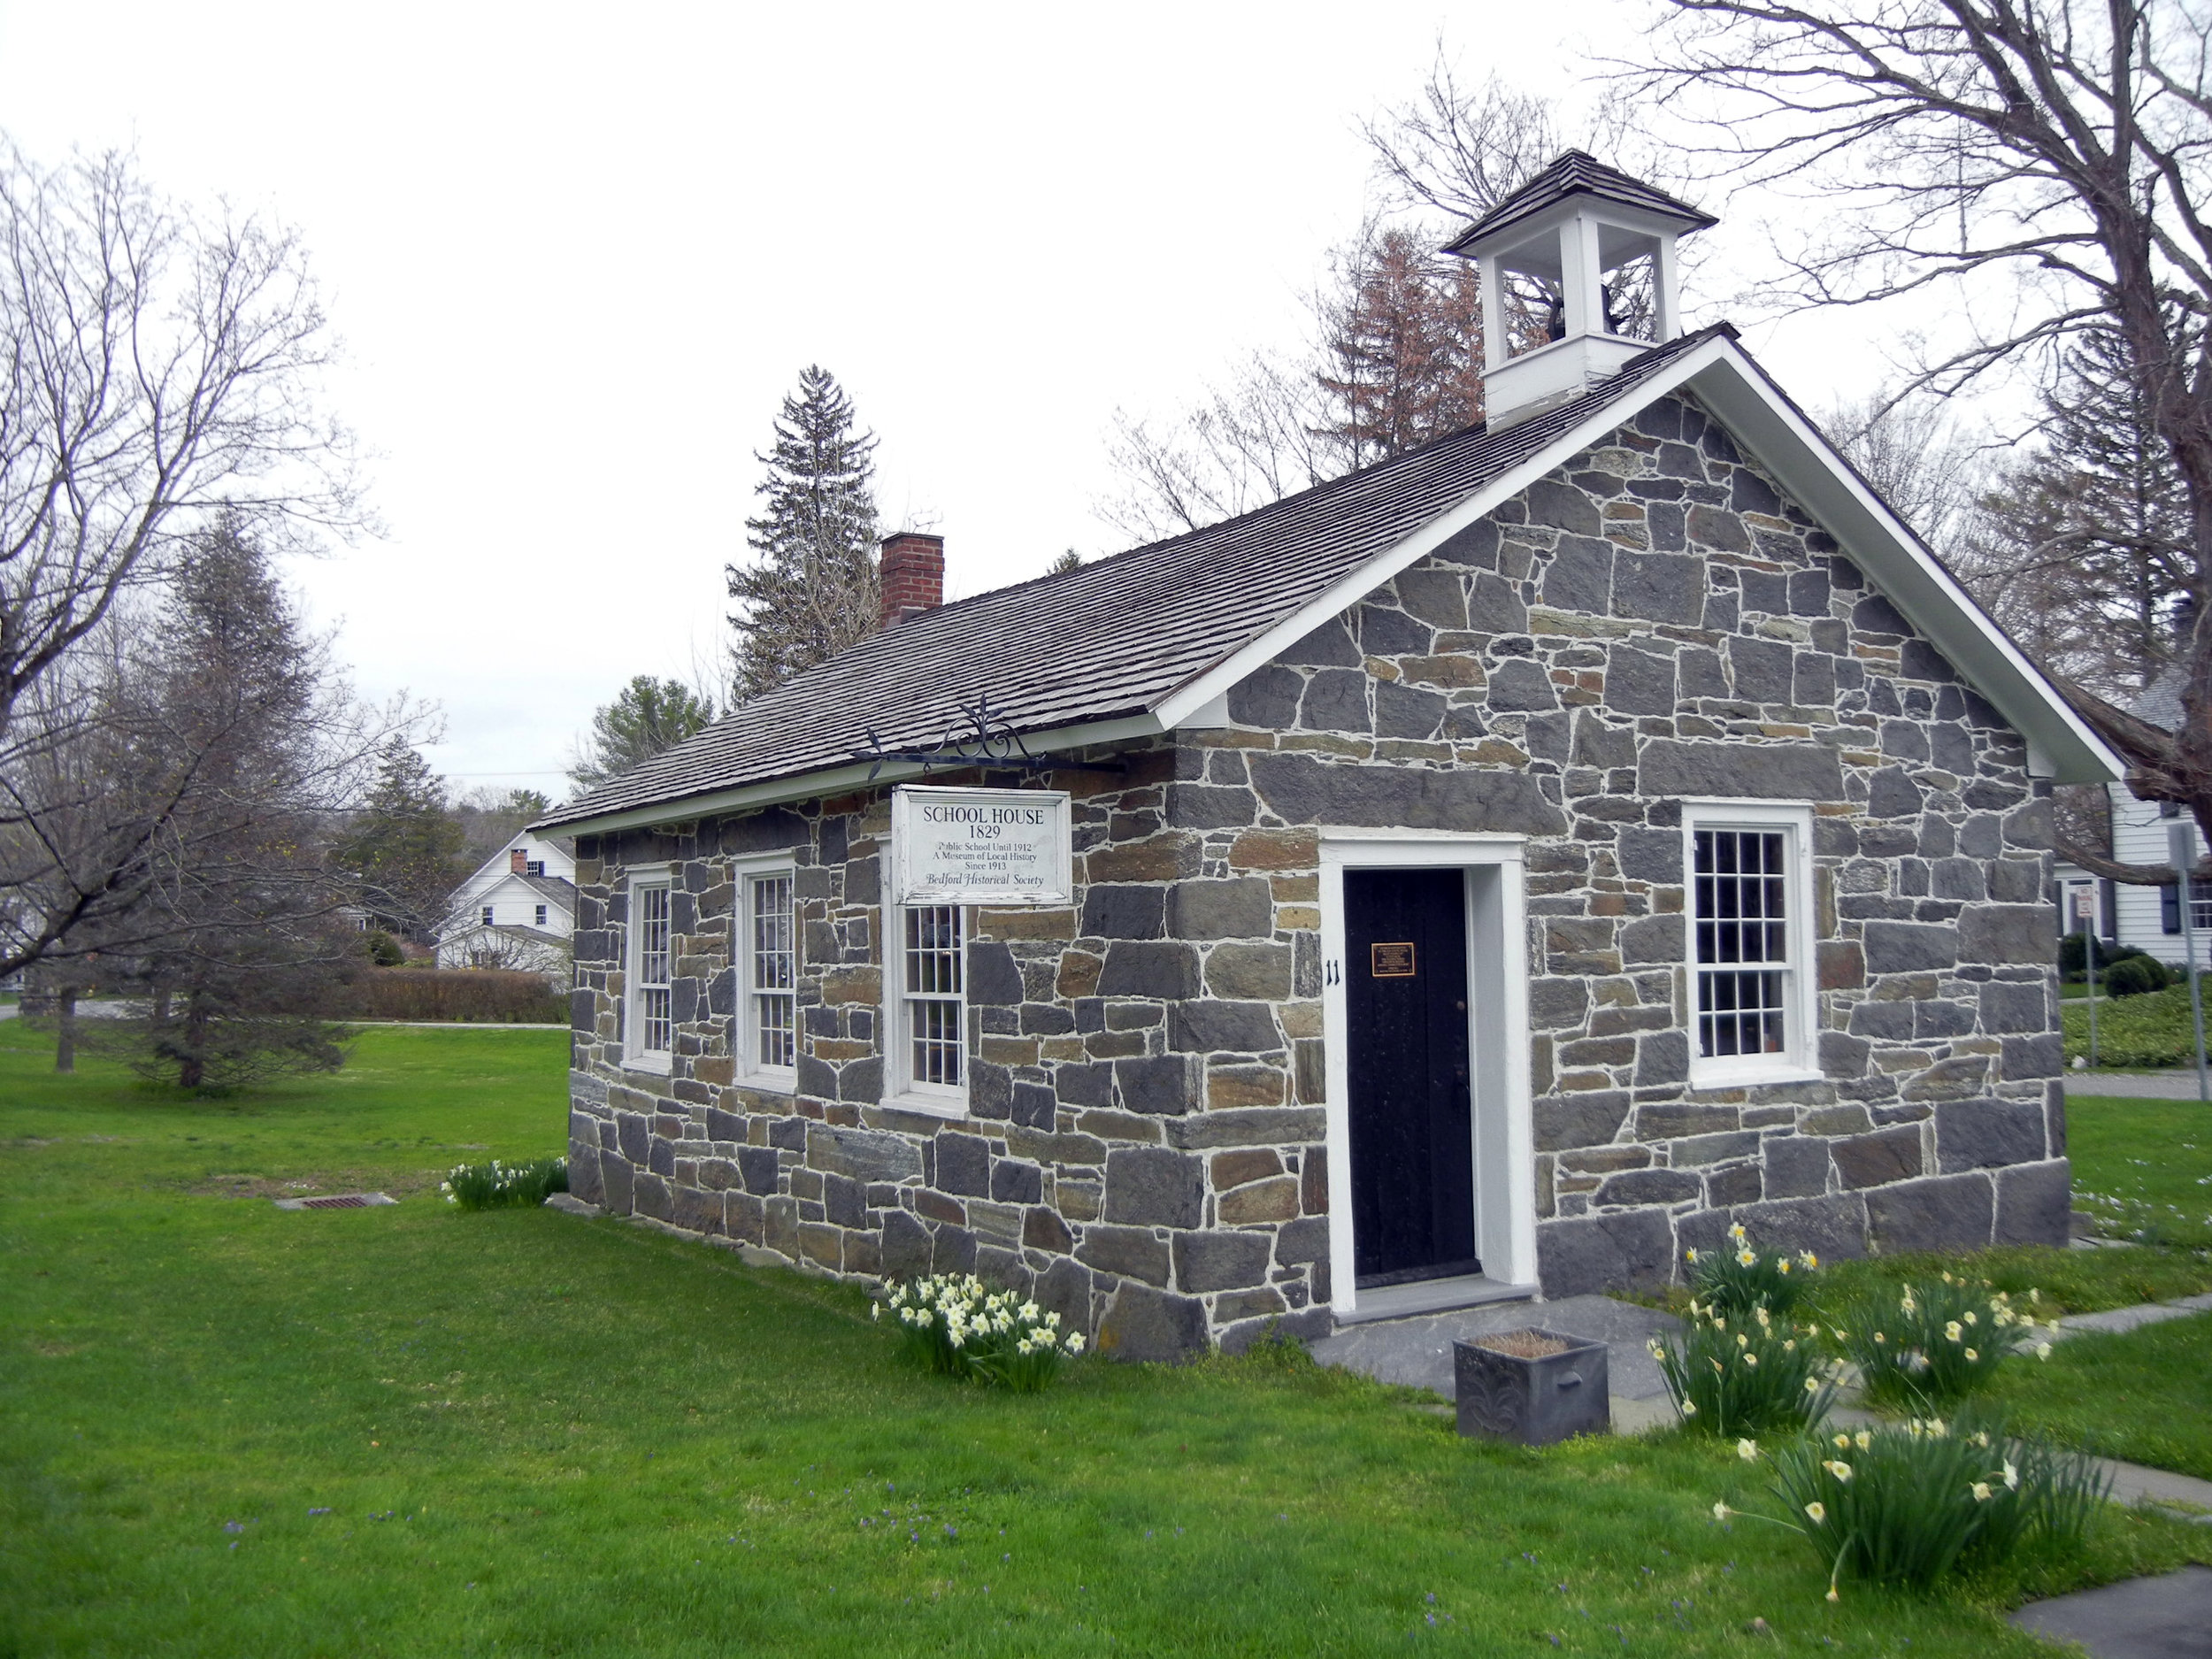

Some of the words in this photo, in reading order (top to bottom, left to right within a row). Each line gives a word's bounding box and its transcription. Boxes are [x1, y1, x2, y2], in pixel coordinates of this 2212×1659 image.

[924, 806, 987, 823] SCHOOL
[992, 809, 1043, 825] HOUSE
[970, 825, 1000, 839] 1829
[939, 841, 963, 850] Public
[964, 842, 990, 851] School
[993, 842, 1011, 851] Until
[977, 851, 987, 860] of
[1010, 852, 1037, 863] History
[926, 872, 963, 887] Bedford
[963, 872, 1010, 887] Historical
[1013, 873, 1044, 887] Society
